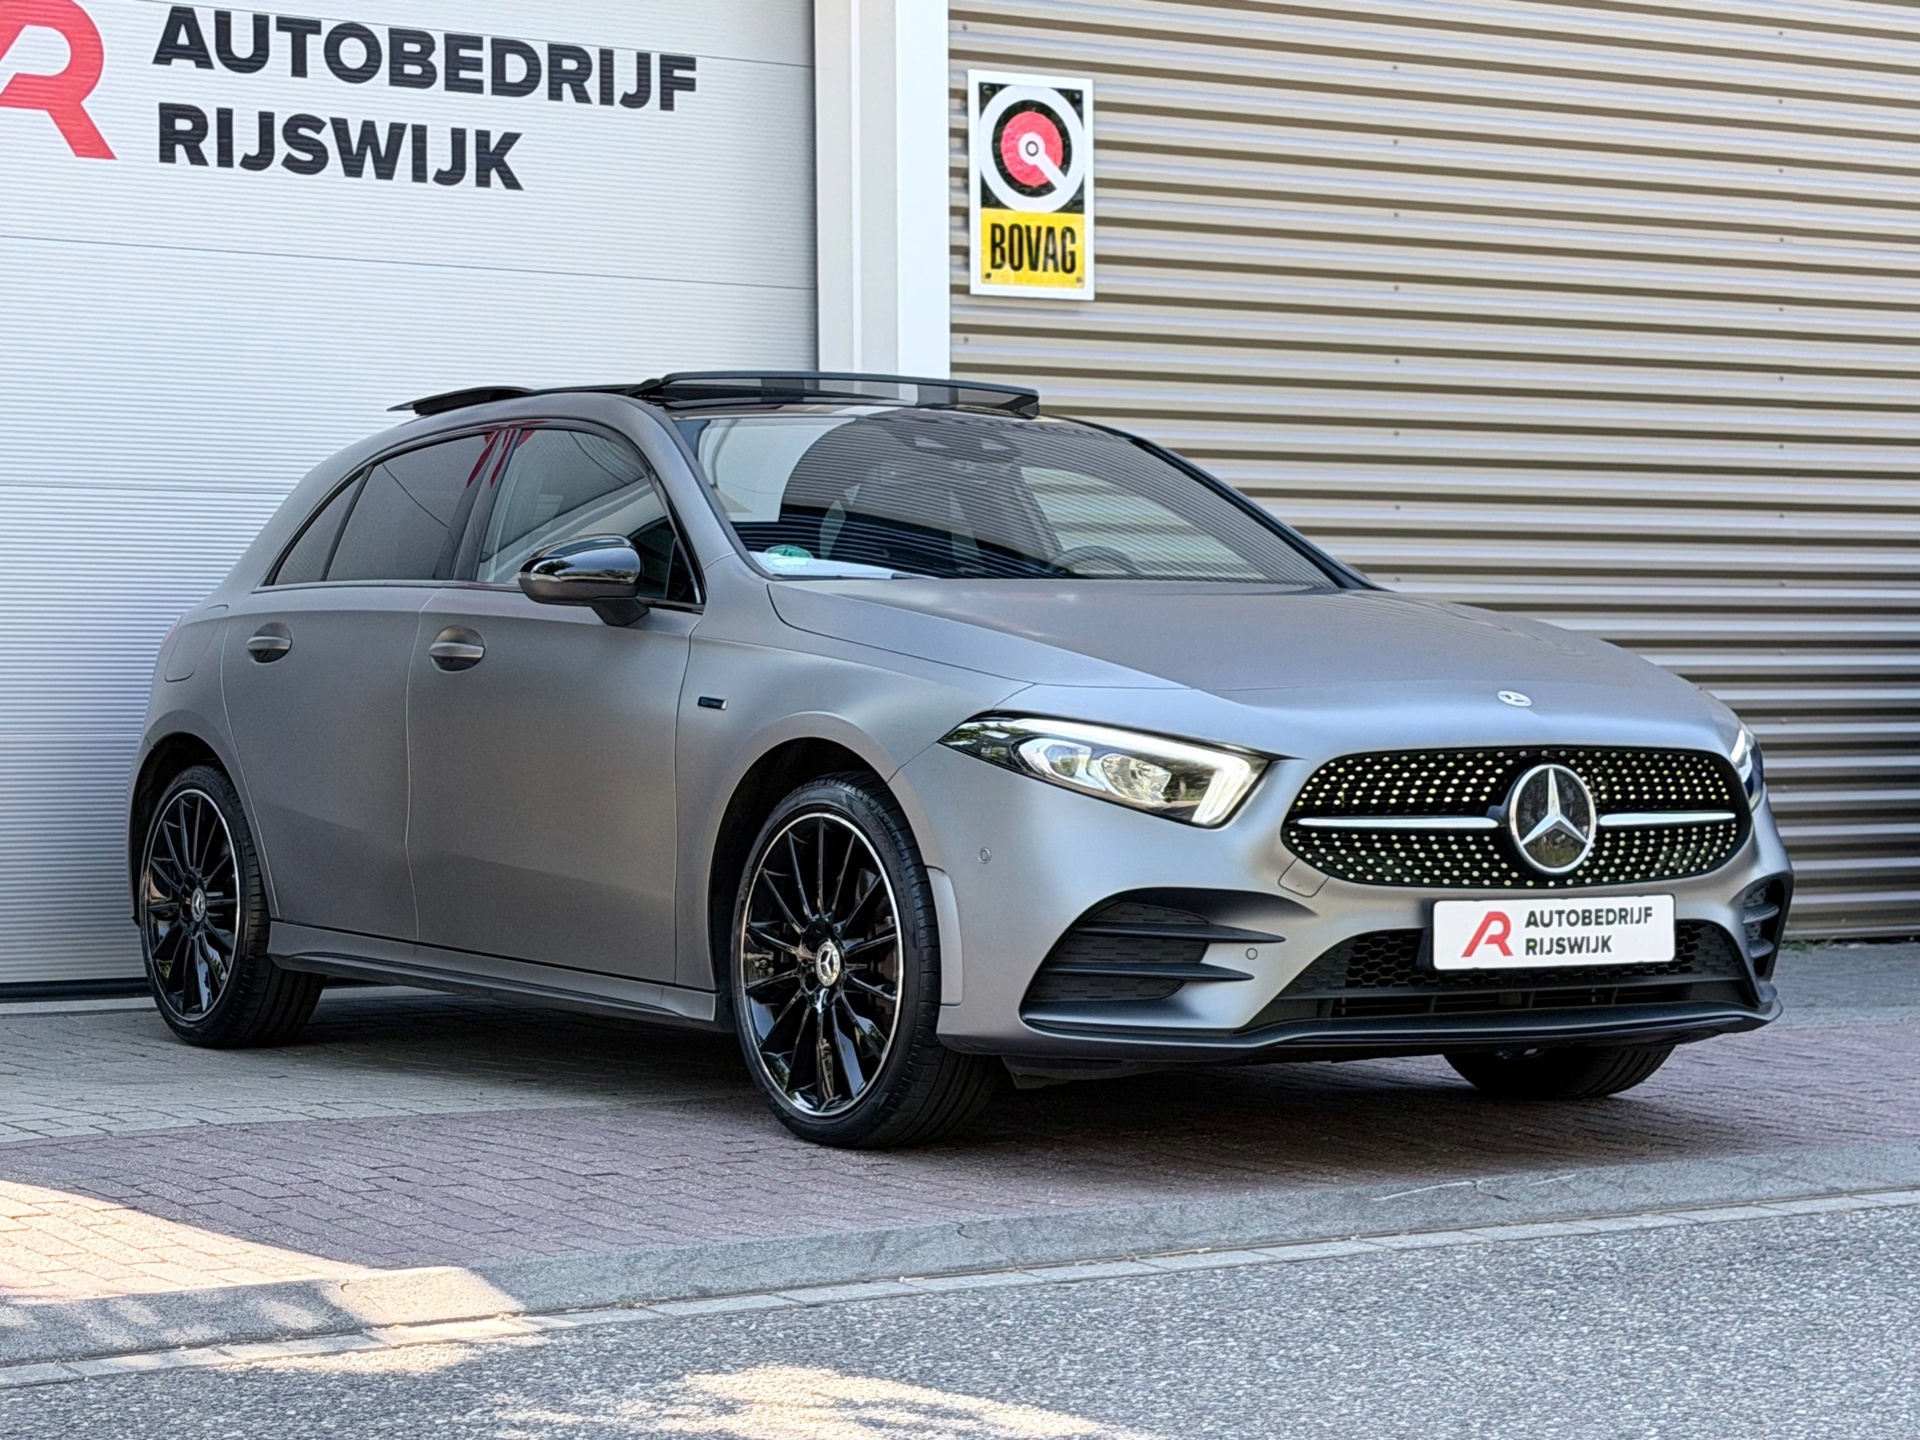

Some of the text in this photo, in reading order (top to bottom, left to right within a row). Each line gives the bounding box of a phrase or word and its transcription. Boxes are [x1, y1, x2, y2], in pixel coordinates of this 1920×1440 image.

[152, 5, 697, 112] AUTOBEDRIJF
[158, 102, 523, 191] RIJSWIJK
[990, 223, 1076, 274] BOVAG
[1524, 906, 1653, 928] AUTOBEDRIJF
[1525, 935, 1612, 956] RIJSWIJK
